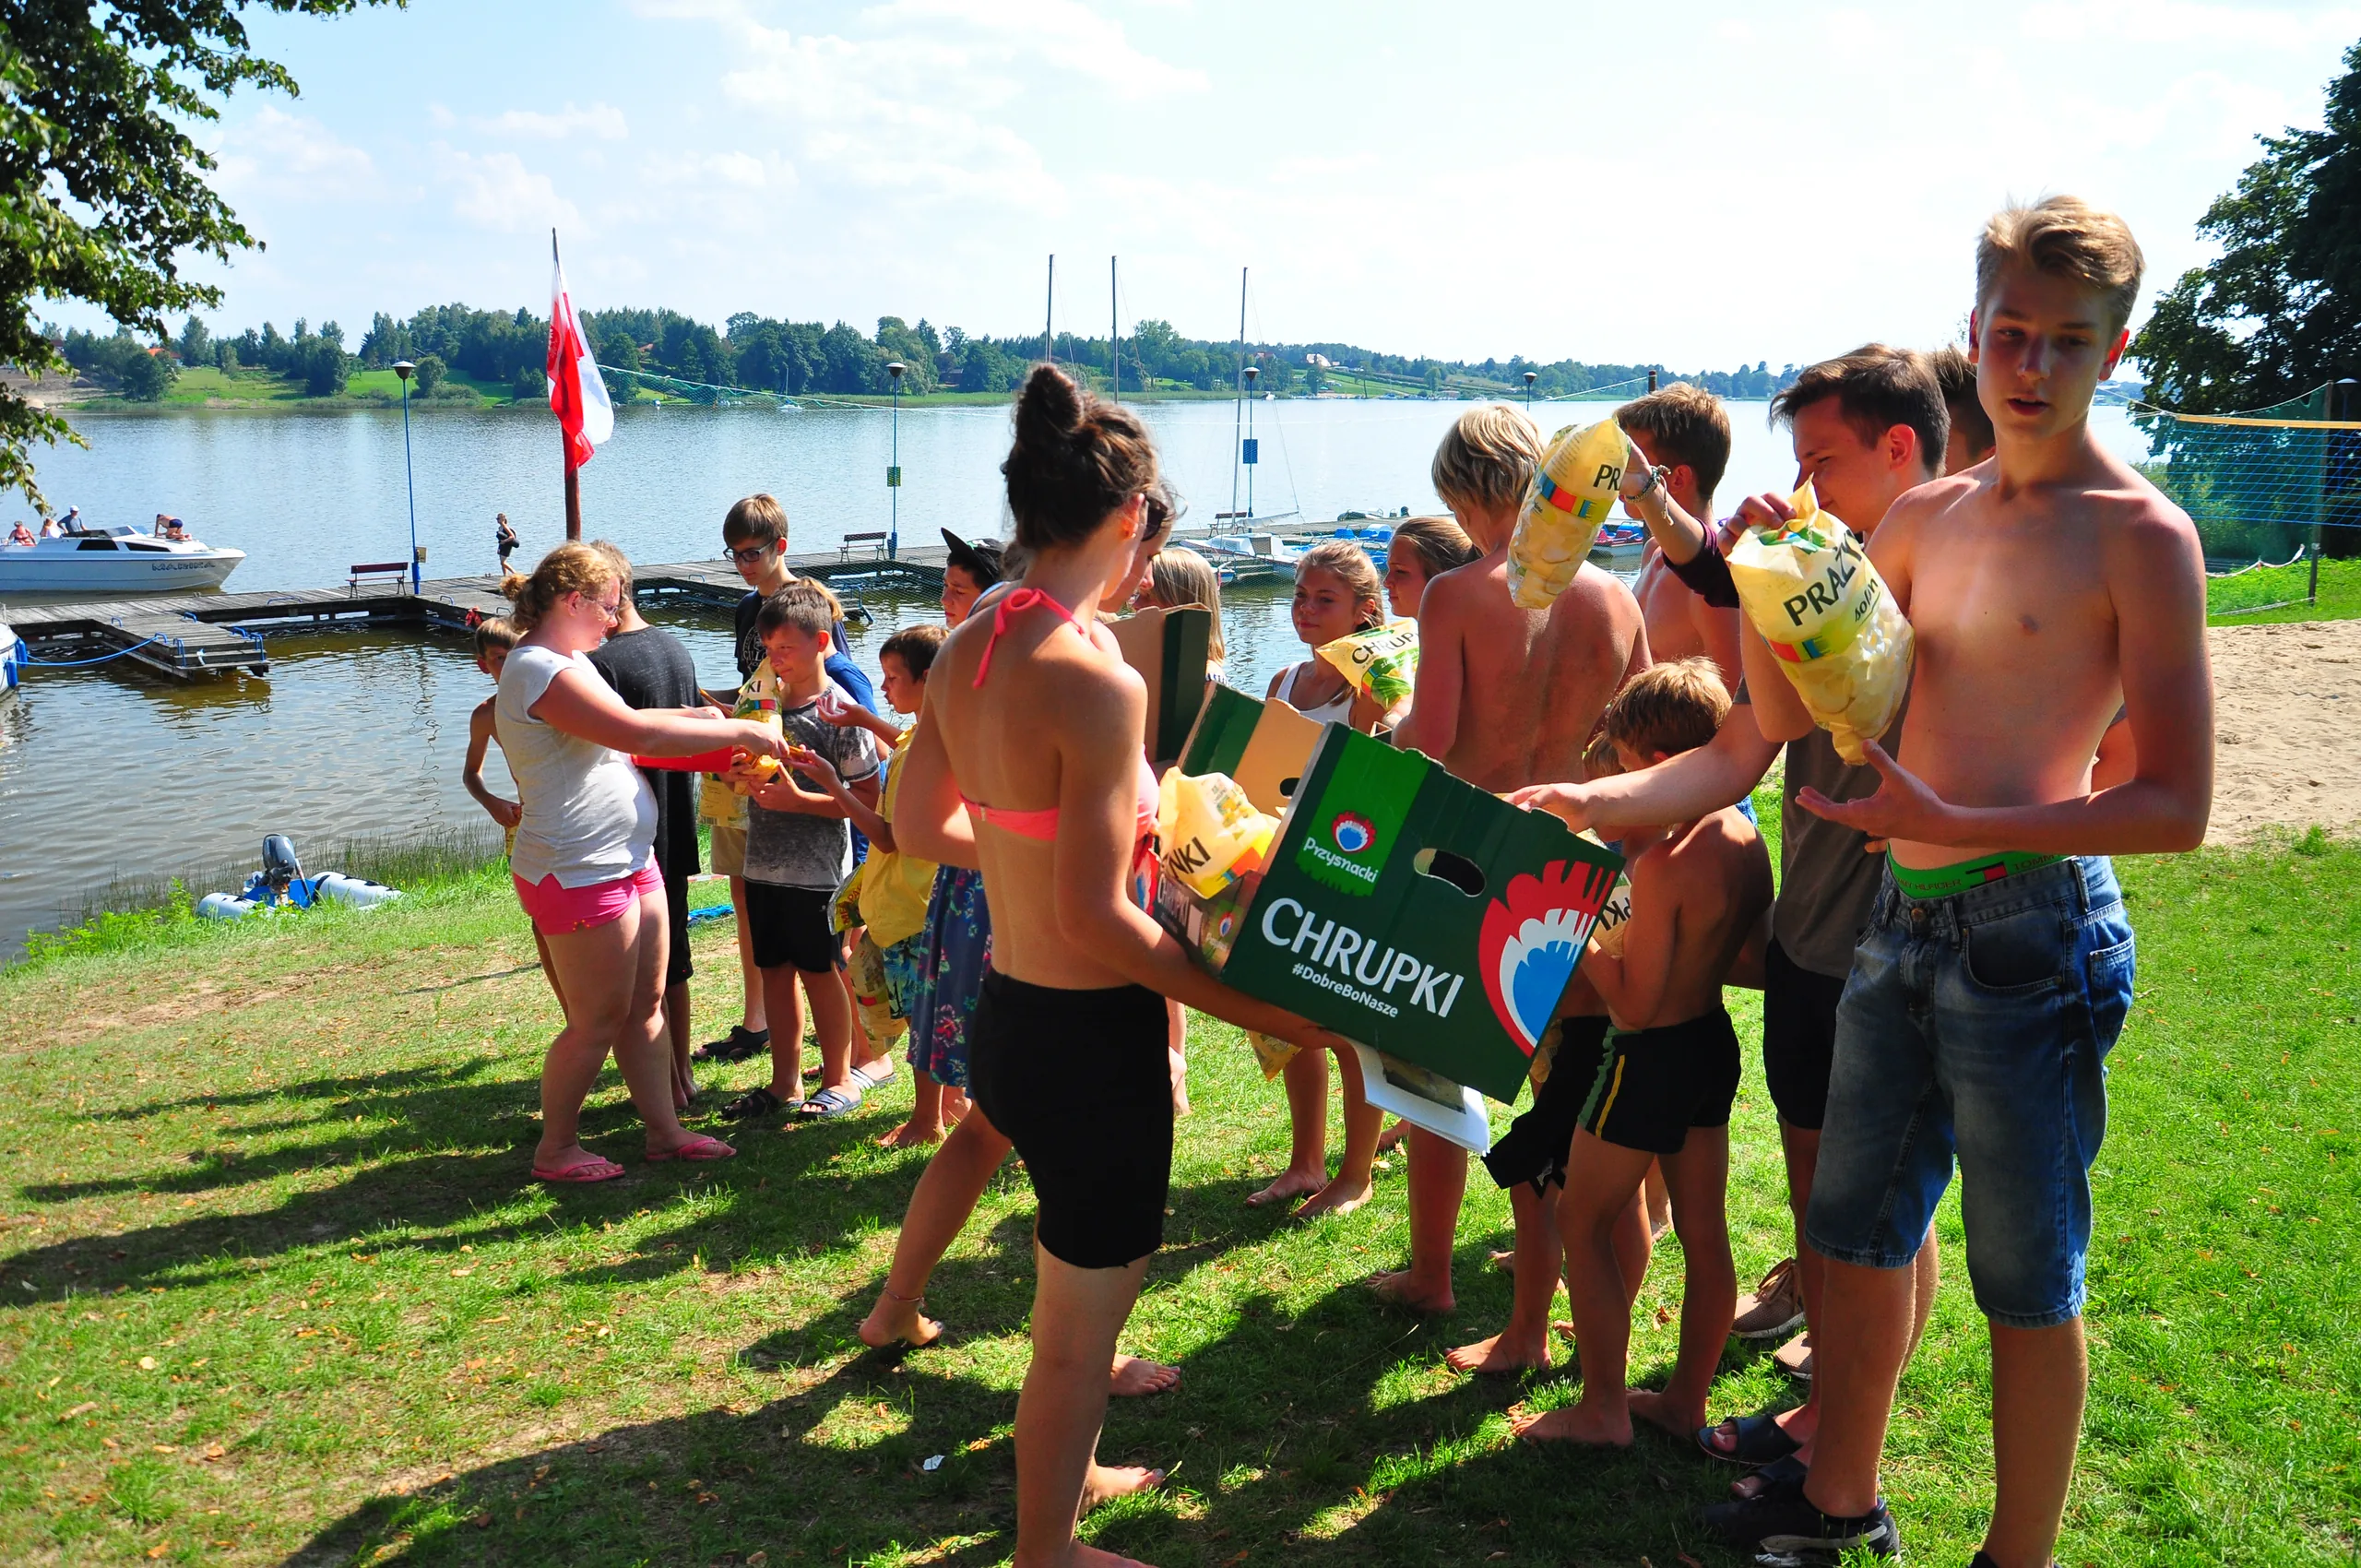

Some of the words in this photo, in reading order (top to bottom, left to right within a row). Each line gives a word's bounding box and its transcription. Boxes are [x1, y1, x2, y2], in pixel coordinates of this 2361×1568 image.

[1593, 464, 1621, 491] PR
[1352, 632, 1418, 664] CHRUP
[1164, 837, 1211, 879] NKI
[1303, 837, 1379, 883] Przysnacki
[1262, 897, 1465, 1017] CHRUPKI
[1292, 963, 1398, 1017] #DobreBoNasze
